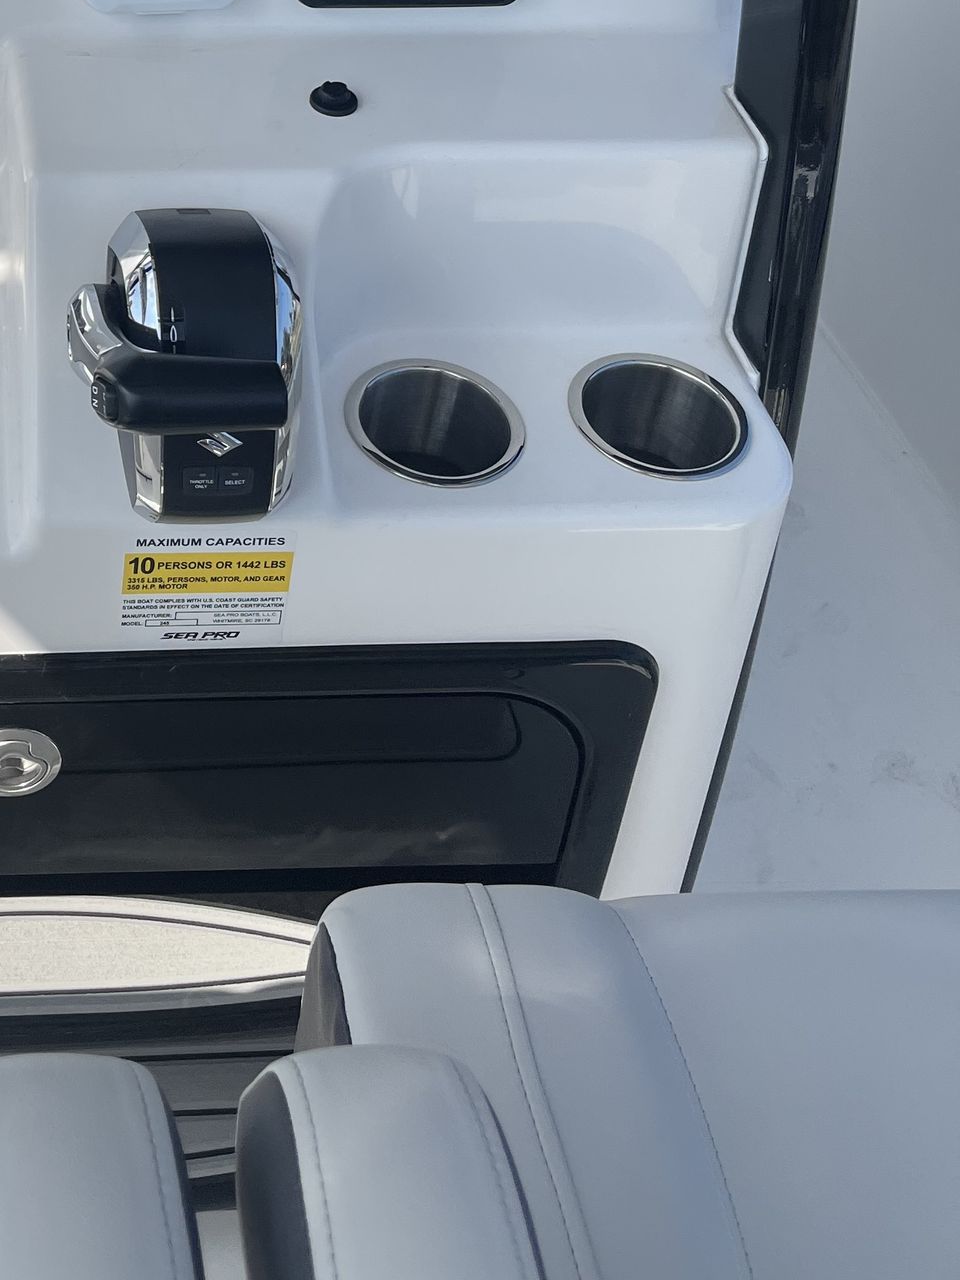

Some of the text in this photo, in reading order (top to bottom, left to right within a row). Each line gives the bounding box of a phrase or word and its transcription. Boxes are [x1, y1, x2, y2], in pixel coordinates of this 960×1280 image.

[136, 537, 286, 547] MAXIMUM CAPACITIES
[128, 556, 286, 575] 10 PERSONS OR 1442 LBS
[160, 631, 241, 640] SEA PRO
